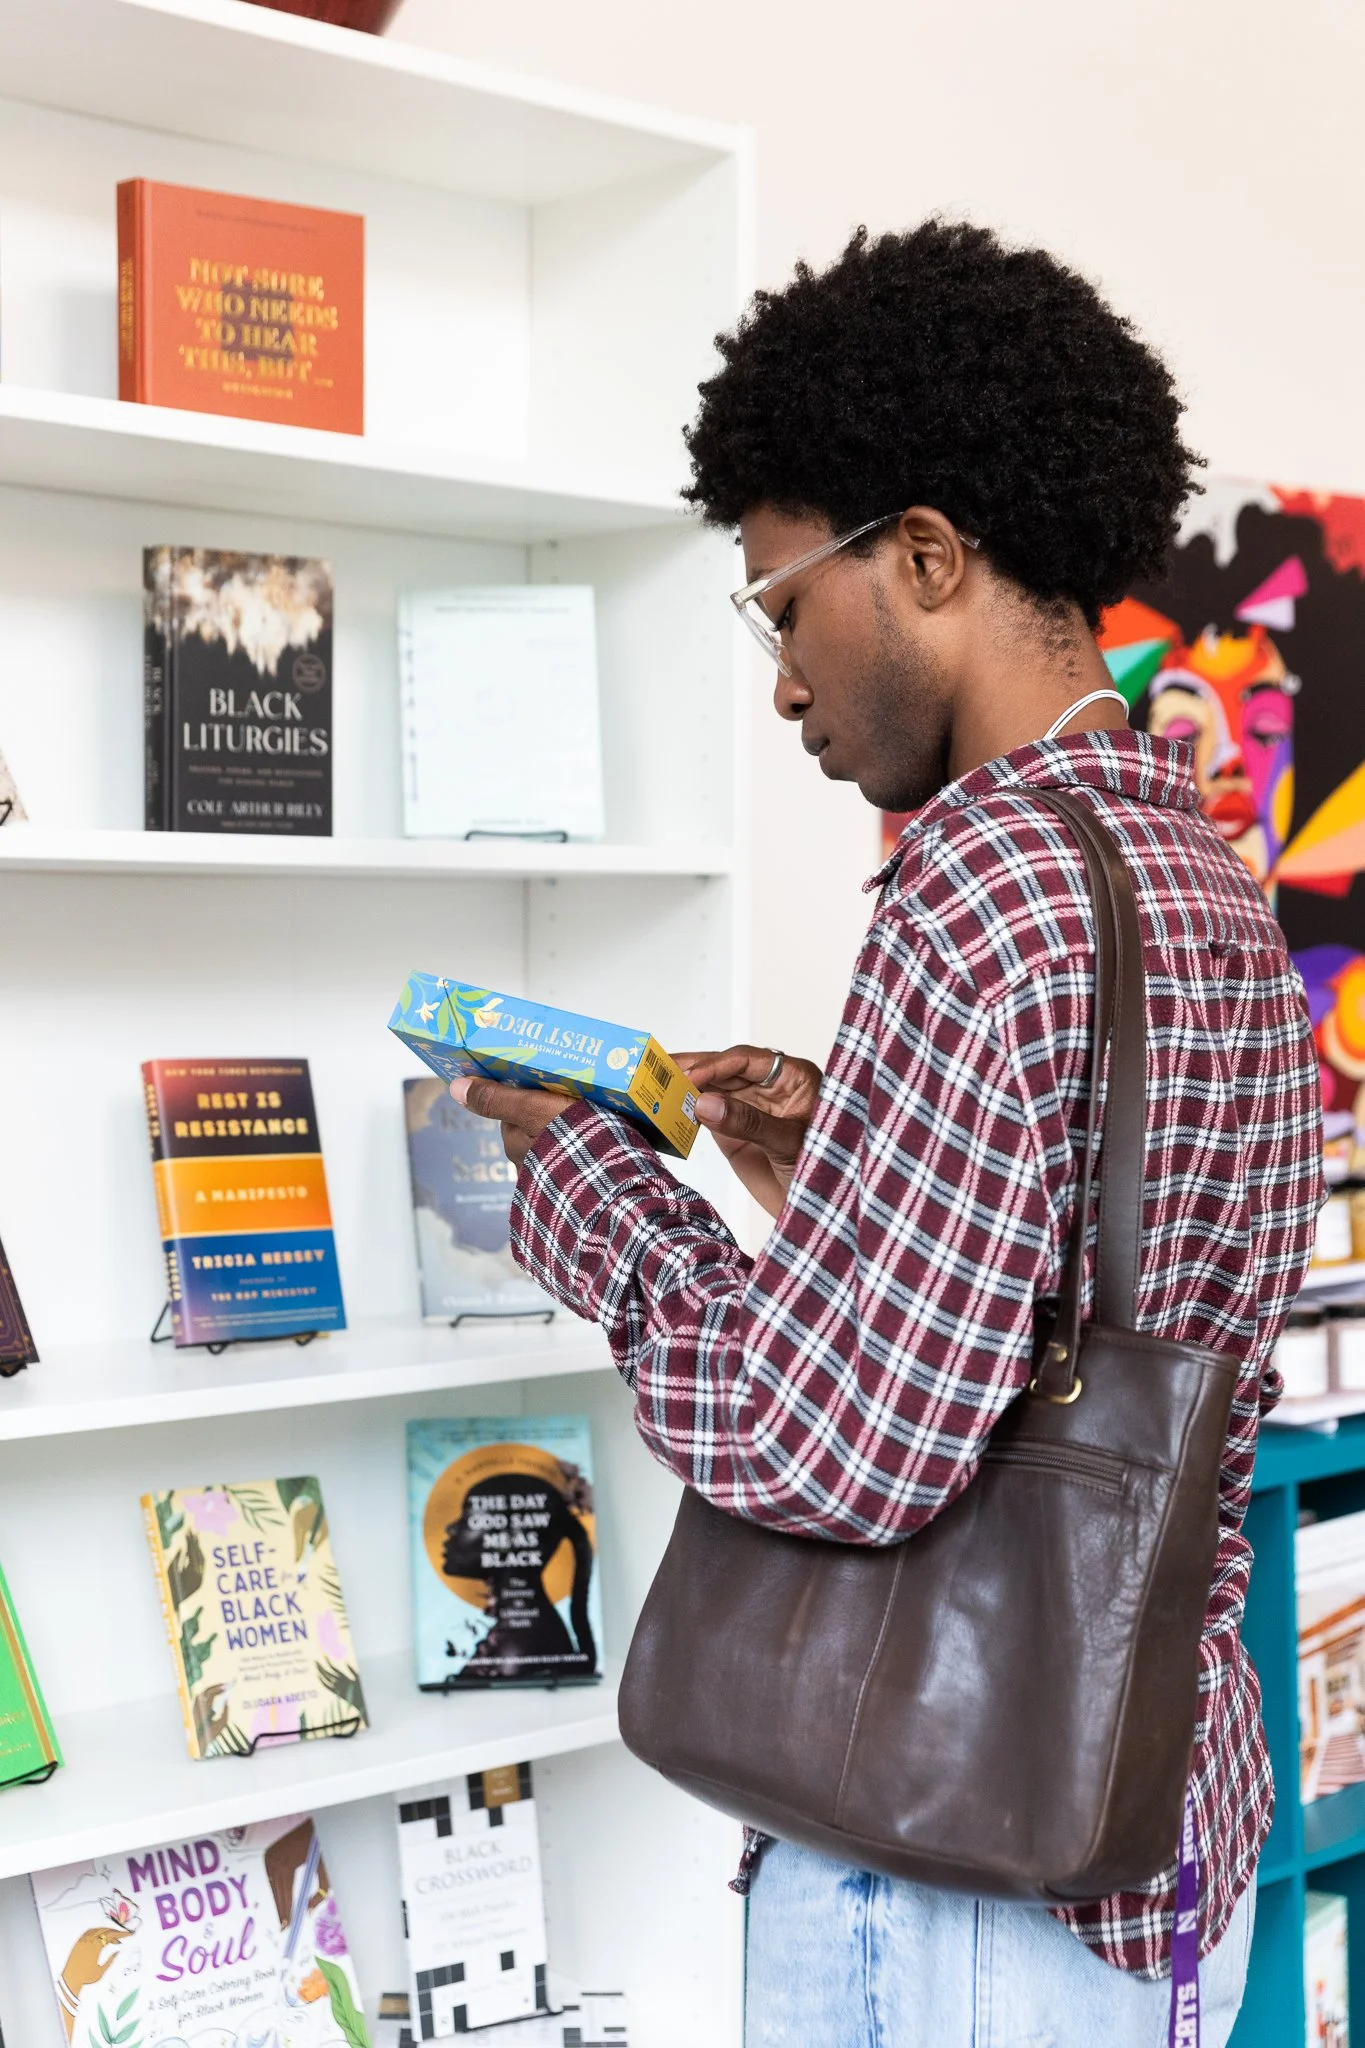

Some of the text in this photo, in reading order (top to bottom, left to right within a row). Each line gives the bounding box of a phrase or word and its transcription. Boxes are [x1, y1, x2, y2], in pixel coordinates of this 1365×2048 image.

[190, 257, 325, 301] NOT SURE
[175, 284, 339, 329] WHO NEEDS
[195, 317, 318, 356] TO HEAR
[209, 687, 303, 720] BLACK
[183, 722, 329, 757] LITURGIES
[544, 1026, 604, 1057] REST
[580, 1056, 596, 1067] THE
[196, 1090, 282, 1110] REST IS
[174, 1117, 310, 1139] RESISTANCE
[194, 1185, 308, 1204] A MANIFESTO
[192, 1248, 326, 1270] TRICIA HERSEY
[467, 1493, 547, 1511] THE DAY
[467, 1511, 551, 1531] GOD SAW
[482, 1531, 539, 1550] ME AS
[212, 1542, 277, 1569] SELF-
[480, 1550, 544, 1569] BLACK
[216, 1568, 280, 1595] CARE
[220, 1591, 304, 1625] BLACK
[226, 1620, 309, 1651] WOMEN
[127, 1838, 230, 1894] MIND,
[443, 1839, 504, 1866] BLACK
[414, 1855, 534, 1896] CROSSWORD
[155, 1873, 260, 1931] BODY,
[155, 1916, 258, 1983] Soul
